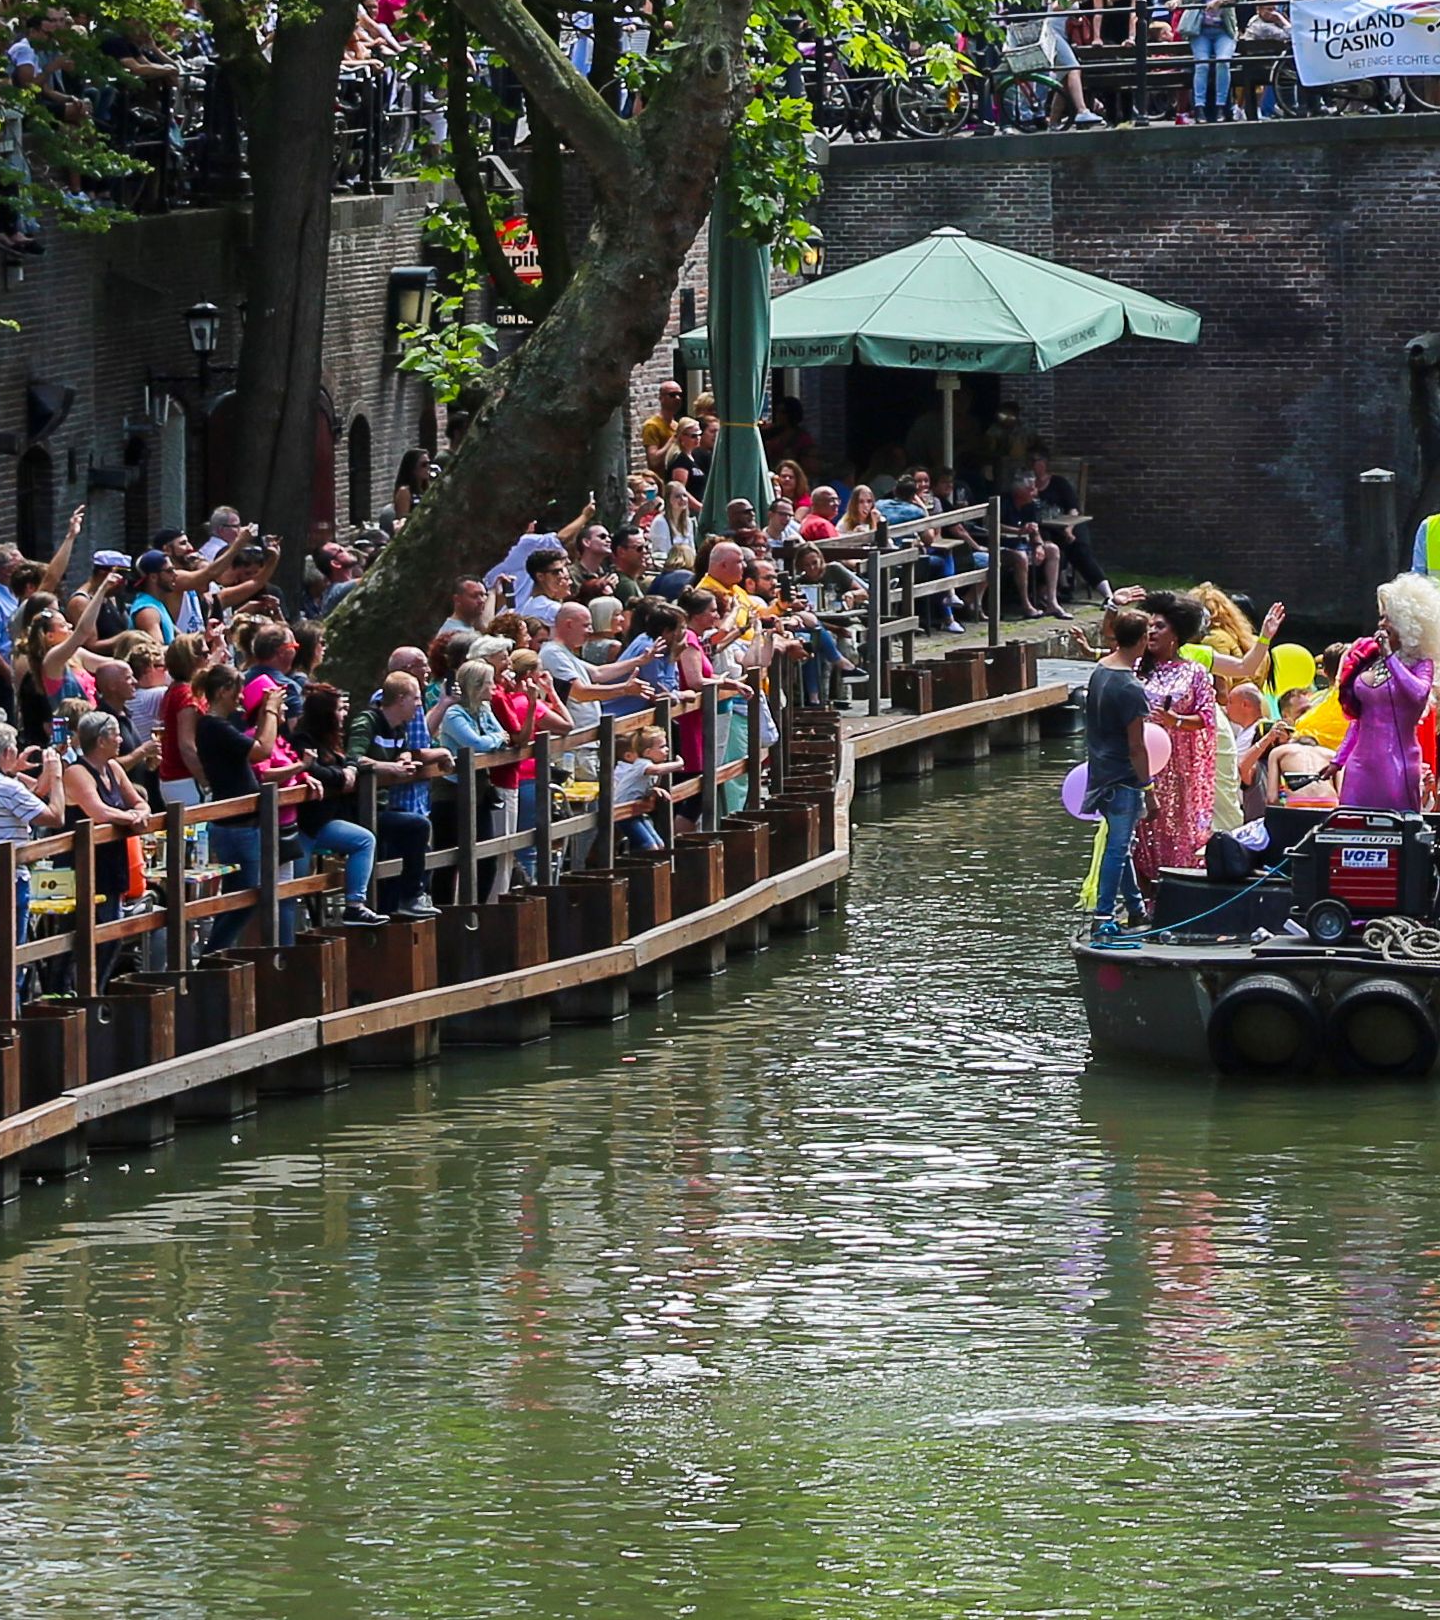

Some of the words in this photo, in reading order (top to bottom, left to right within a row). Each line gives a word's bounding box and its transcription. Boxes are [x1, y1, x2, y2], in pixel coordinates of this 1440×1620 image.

[1310, 13, 1405, 42] HOLLAND
[1325, 32, 1395, 60] CASINO
[1397, 54, 1430, 65] ECHTE
[780, 346, 805, 358] AND
[809, 344, 844, 357] MORE
[1343, 850, 1387, 861] VOET
